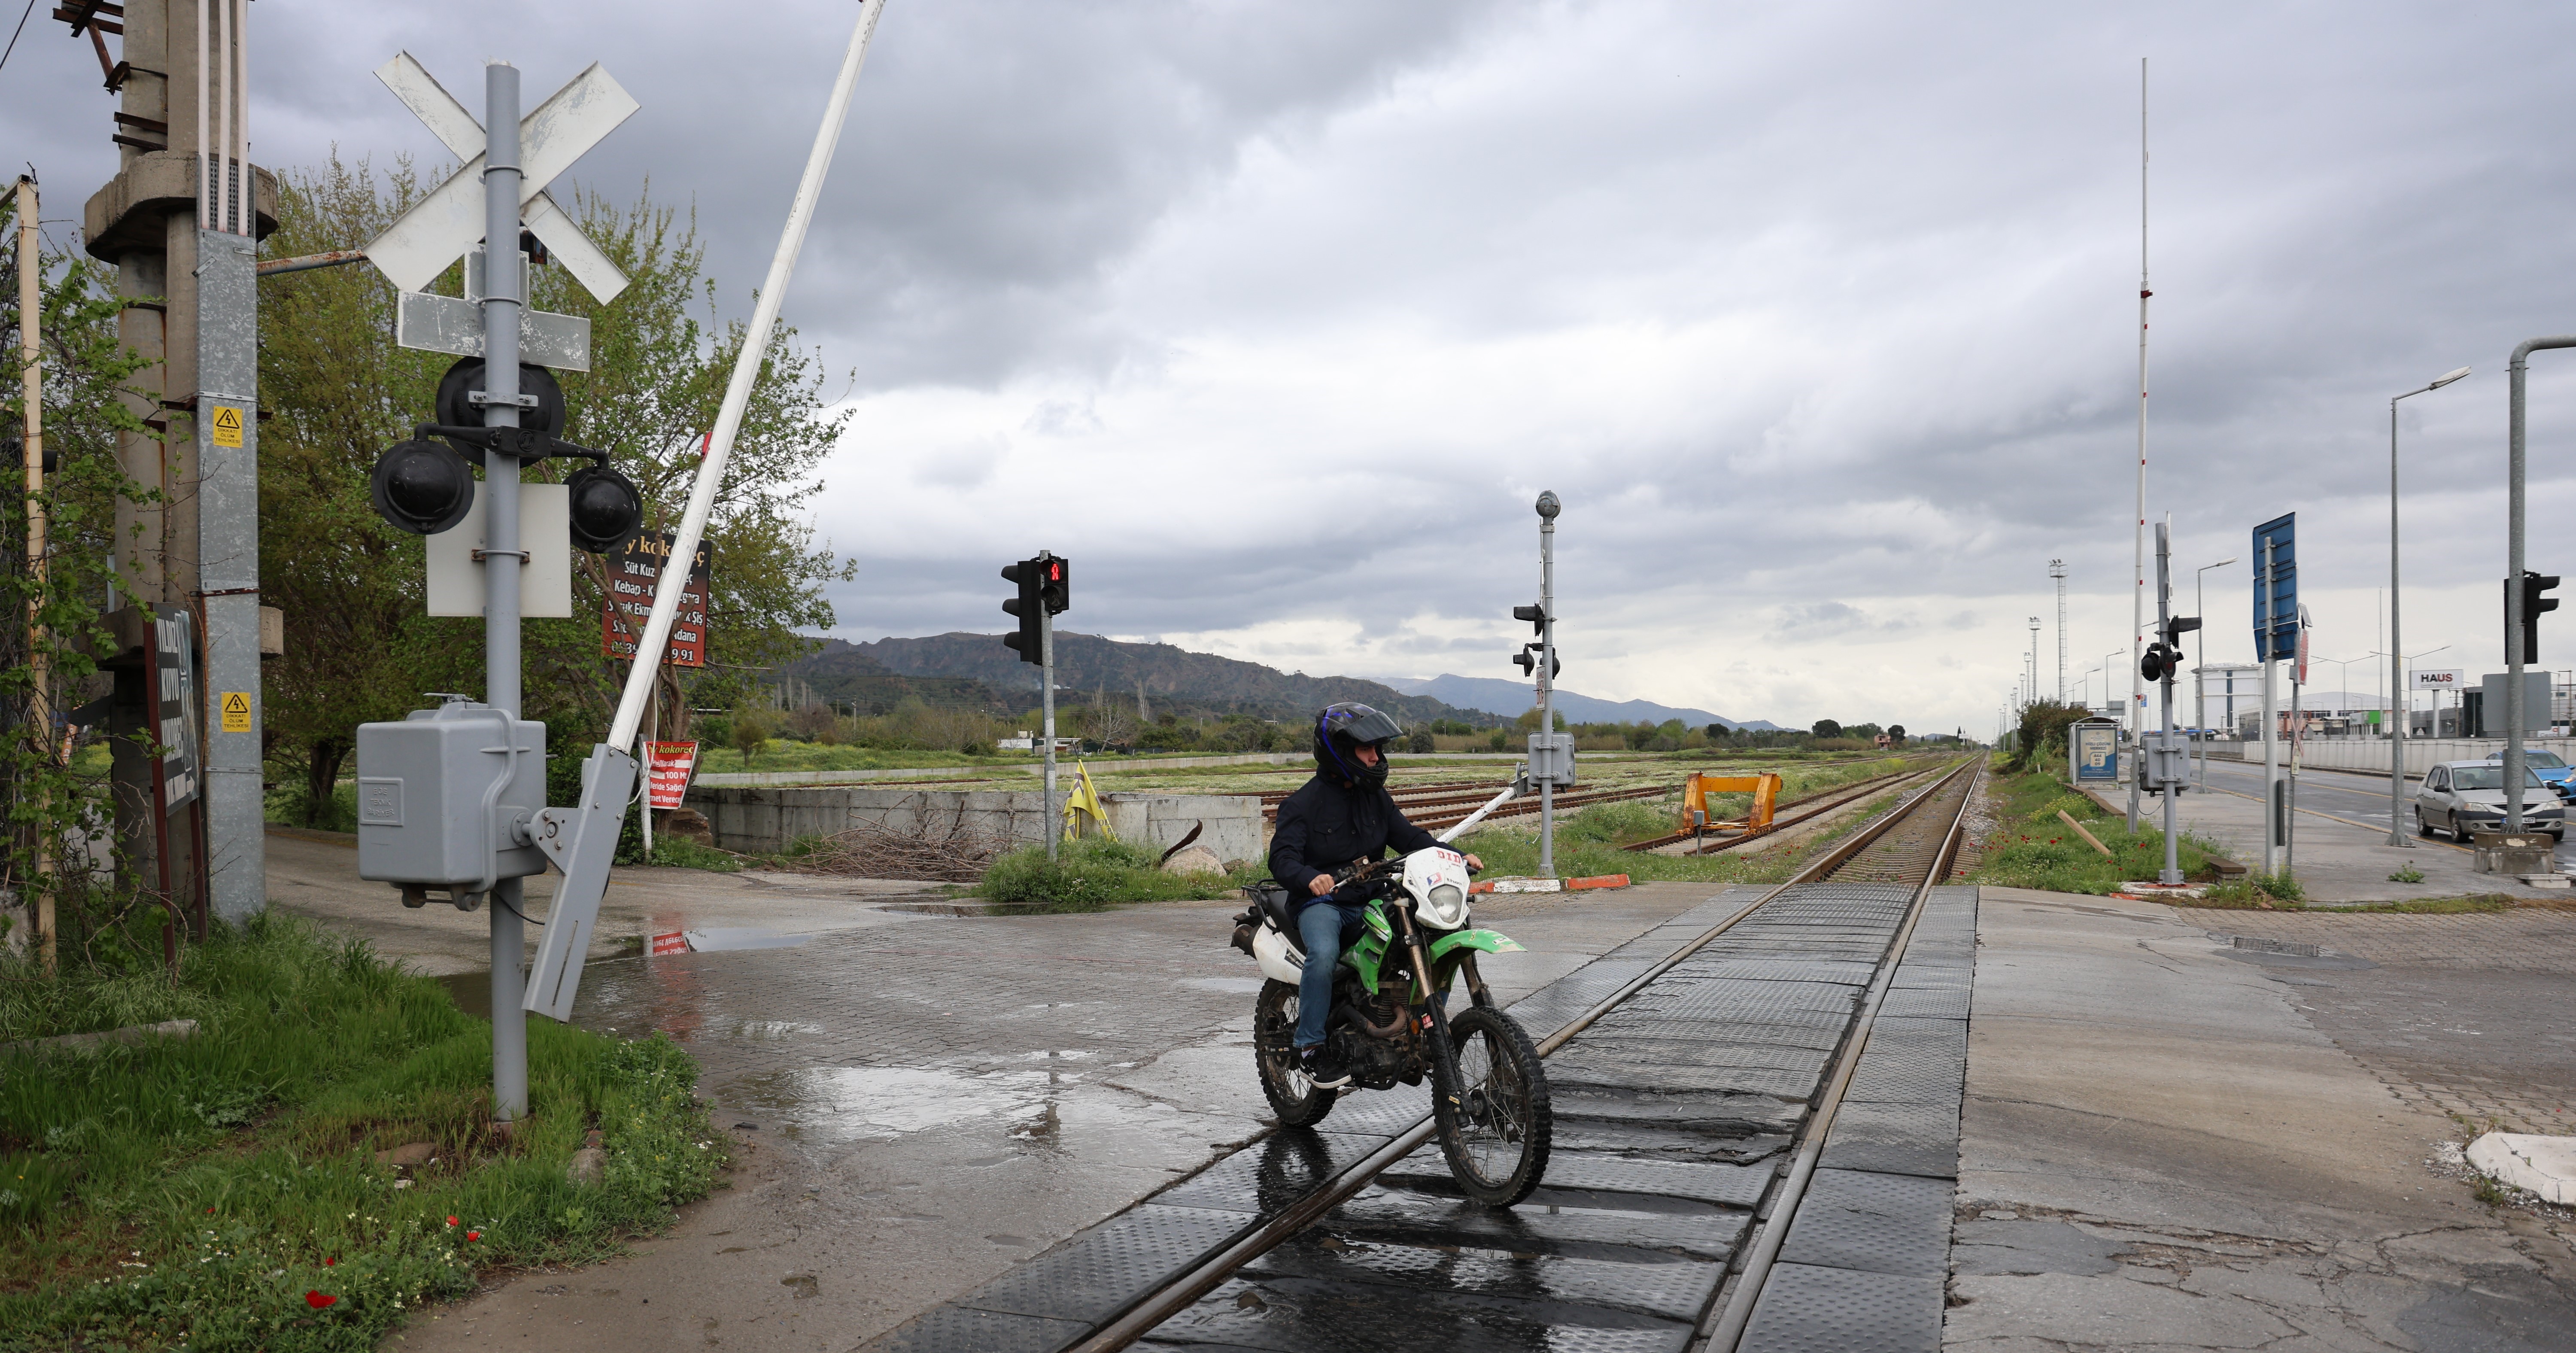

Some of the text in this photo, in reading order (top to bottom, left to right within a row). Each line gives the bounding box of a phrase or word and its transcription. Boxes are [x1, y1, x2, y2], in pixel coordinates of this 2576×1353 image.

[624, 561, 638, 575] Süt
[640, 563, 655, 577] Kuz
[614, 580, 641, 596] Kebap
[692, 611, 703, 626] Şiş
[156, 617, 178, 653] YILDIZ
[161, 668, 179, 702] KUYU
[2421, 673, 2453, 682] HAUS
[659, 745, 694, 756] kokoreç
[650, 781, 684, 792] leride Sağda
[662, 794, 681, 803] Verece
